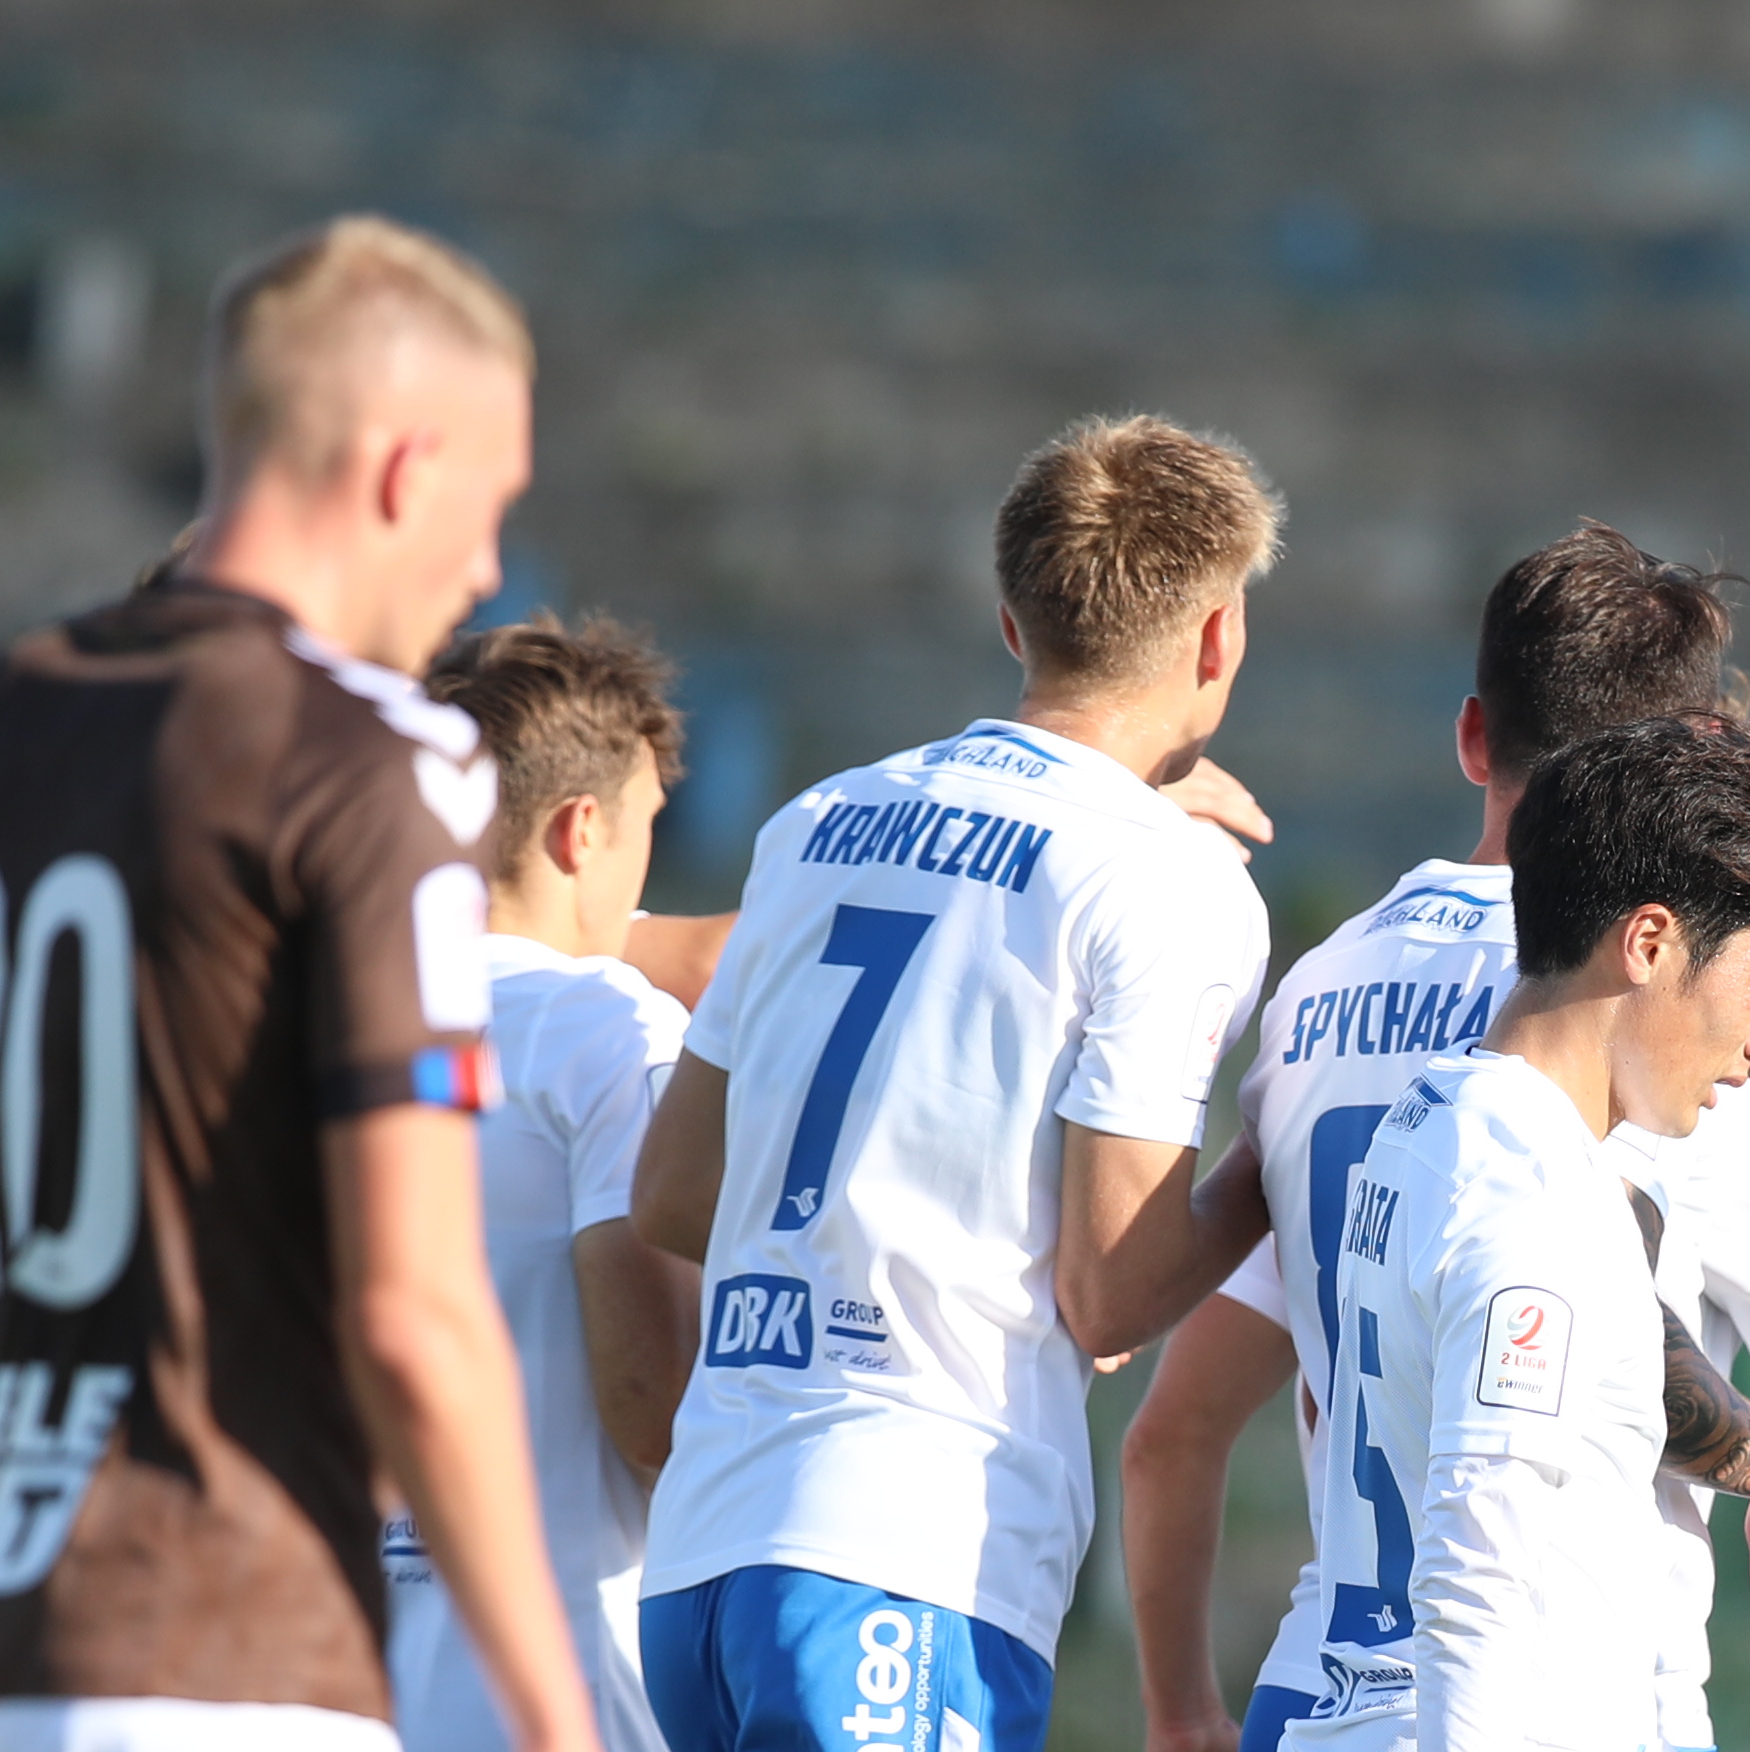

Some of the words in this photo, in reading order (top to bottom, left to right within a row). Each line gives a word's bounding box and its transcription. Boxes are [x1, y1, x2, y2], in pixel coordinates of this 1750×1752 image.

[798, 799, 1054, 894] KRAWCZUN
[770, 903, 937, 1231] 7
[1282, 981, 1495, 1065] SPYCHAŁA
[1346, 1178, 1400, 1266] RATA
[714, 1286, 807, 1358] DBK
[1514, 1354, 1547, 1371] LIGA
[915, 1610, 935, 1711] opportunities
